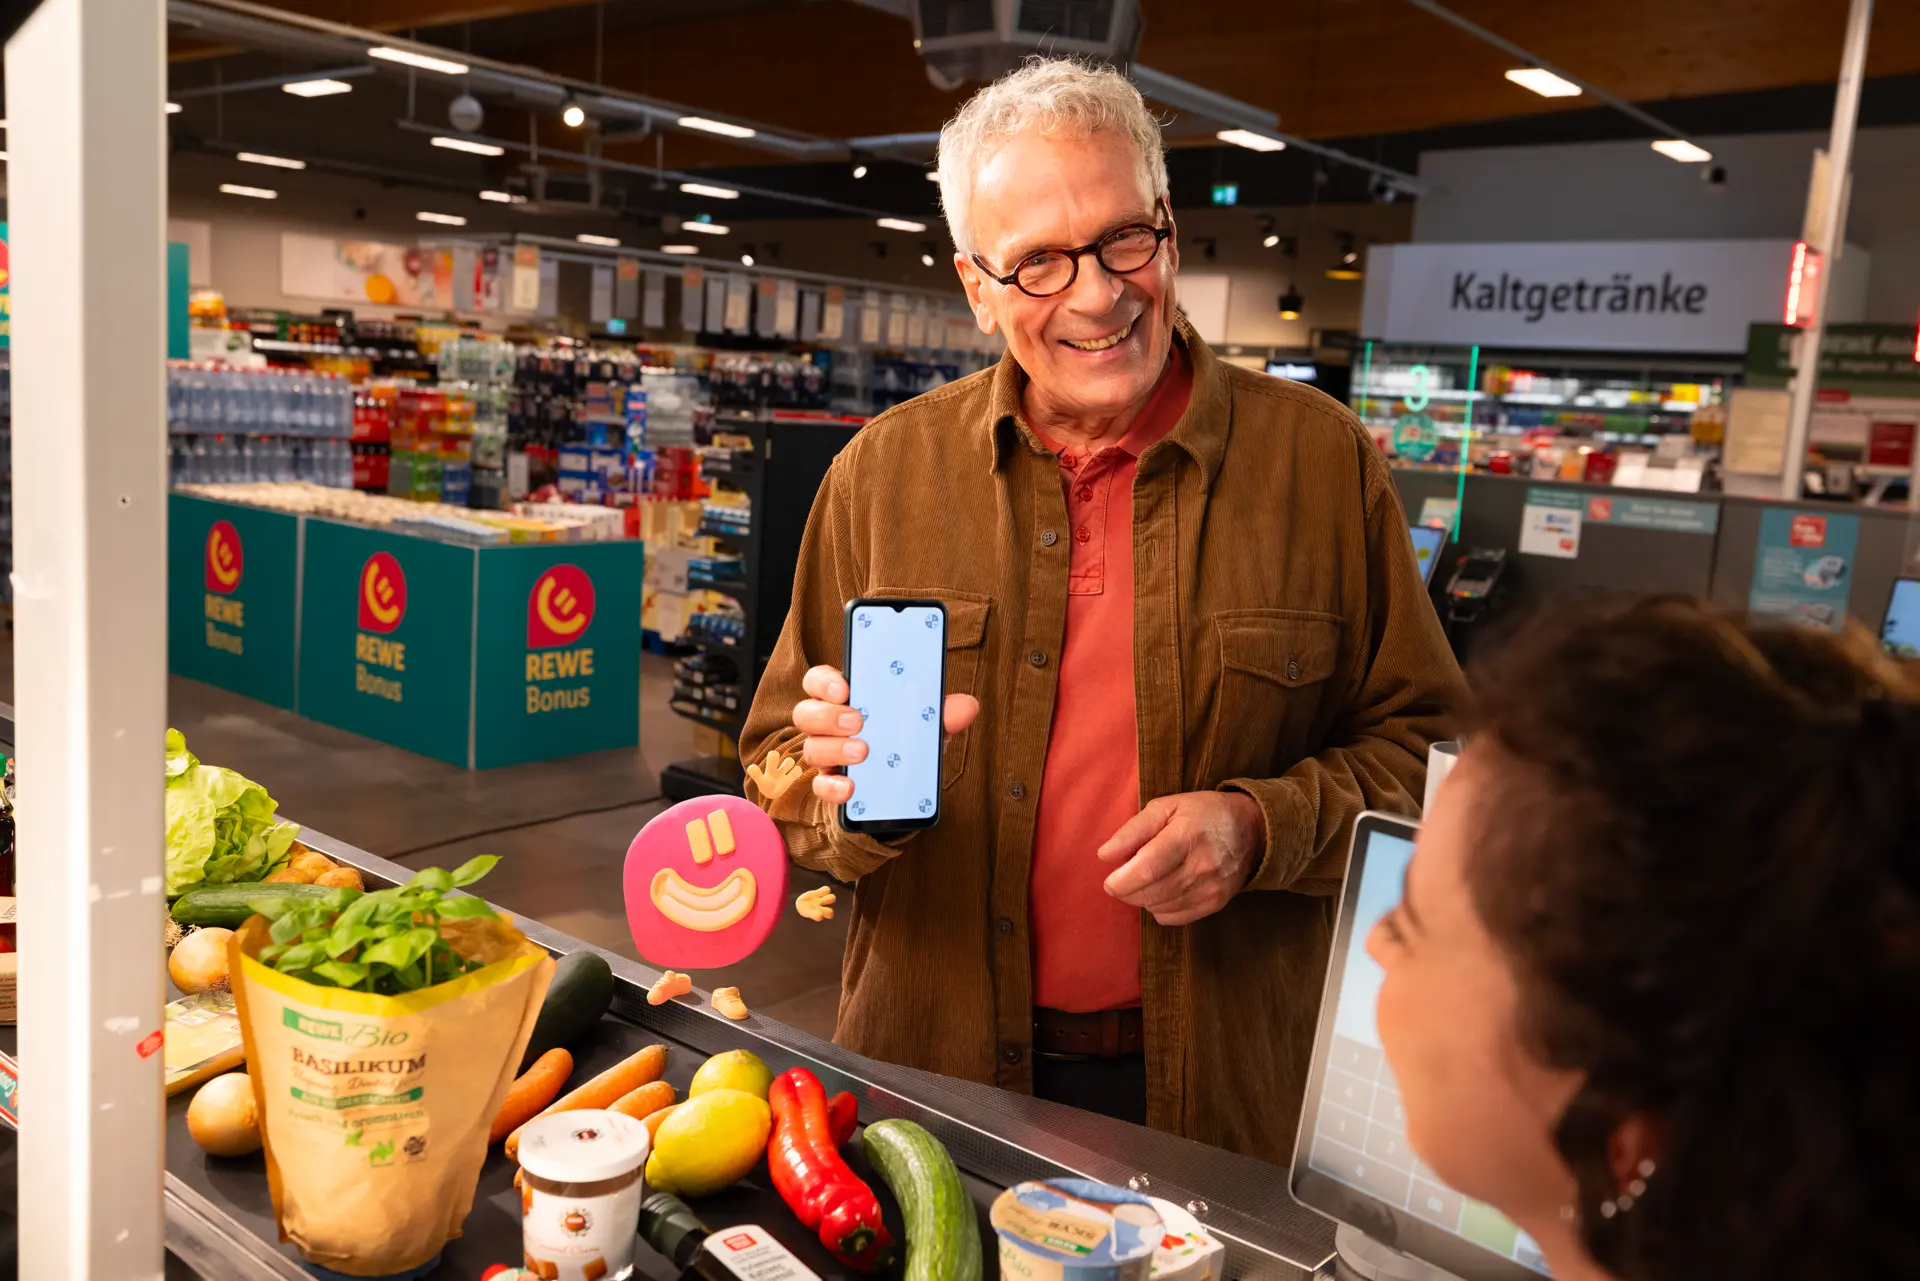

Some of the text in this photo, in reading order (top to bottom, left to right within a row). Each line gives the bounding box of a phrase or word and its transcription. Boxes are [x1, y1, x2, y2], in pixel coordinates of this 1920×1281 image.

[1451, 271, 1709, 323] Kaltgetränke
[1404, 364, 1430, 412] 3
[205, 593, 244, 627] REWE
[206, 621, 243, 655] Bonus
[356, 632, 405, 671] REWE
[526, 648, 594, 681] REWE
[356, 663, 403, 702] Bonus
[526, 685, 590, 713] Bonus
[344, 1023, 408, 1049] Bio
[292, 1046, 427, 1076] BASILIKUM
